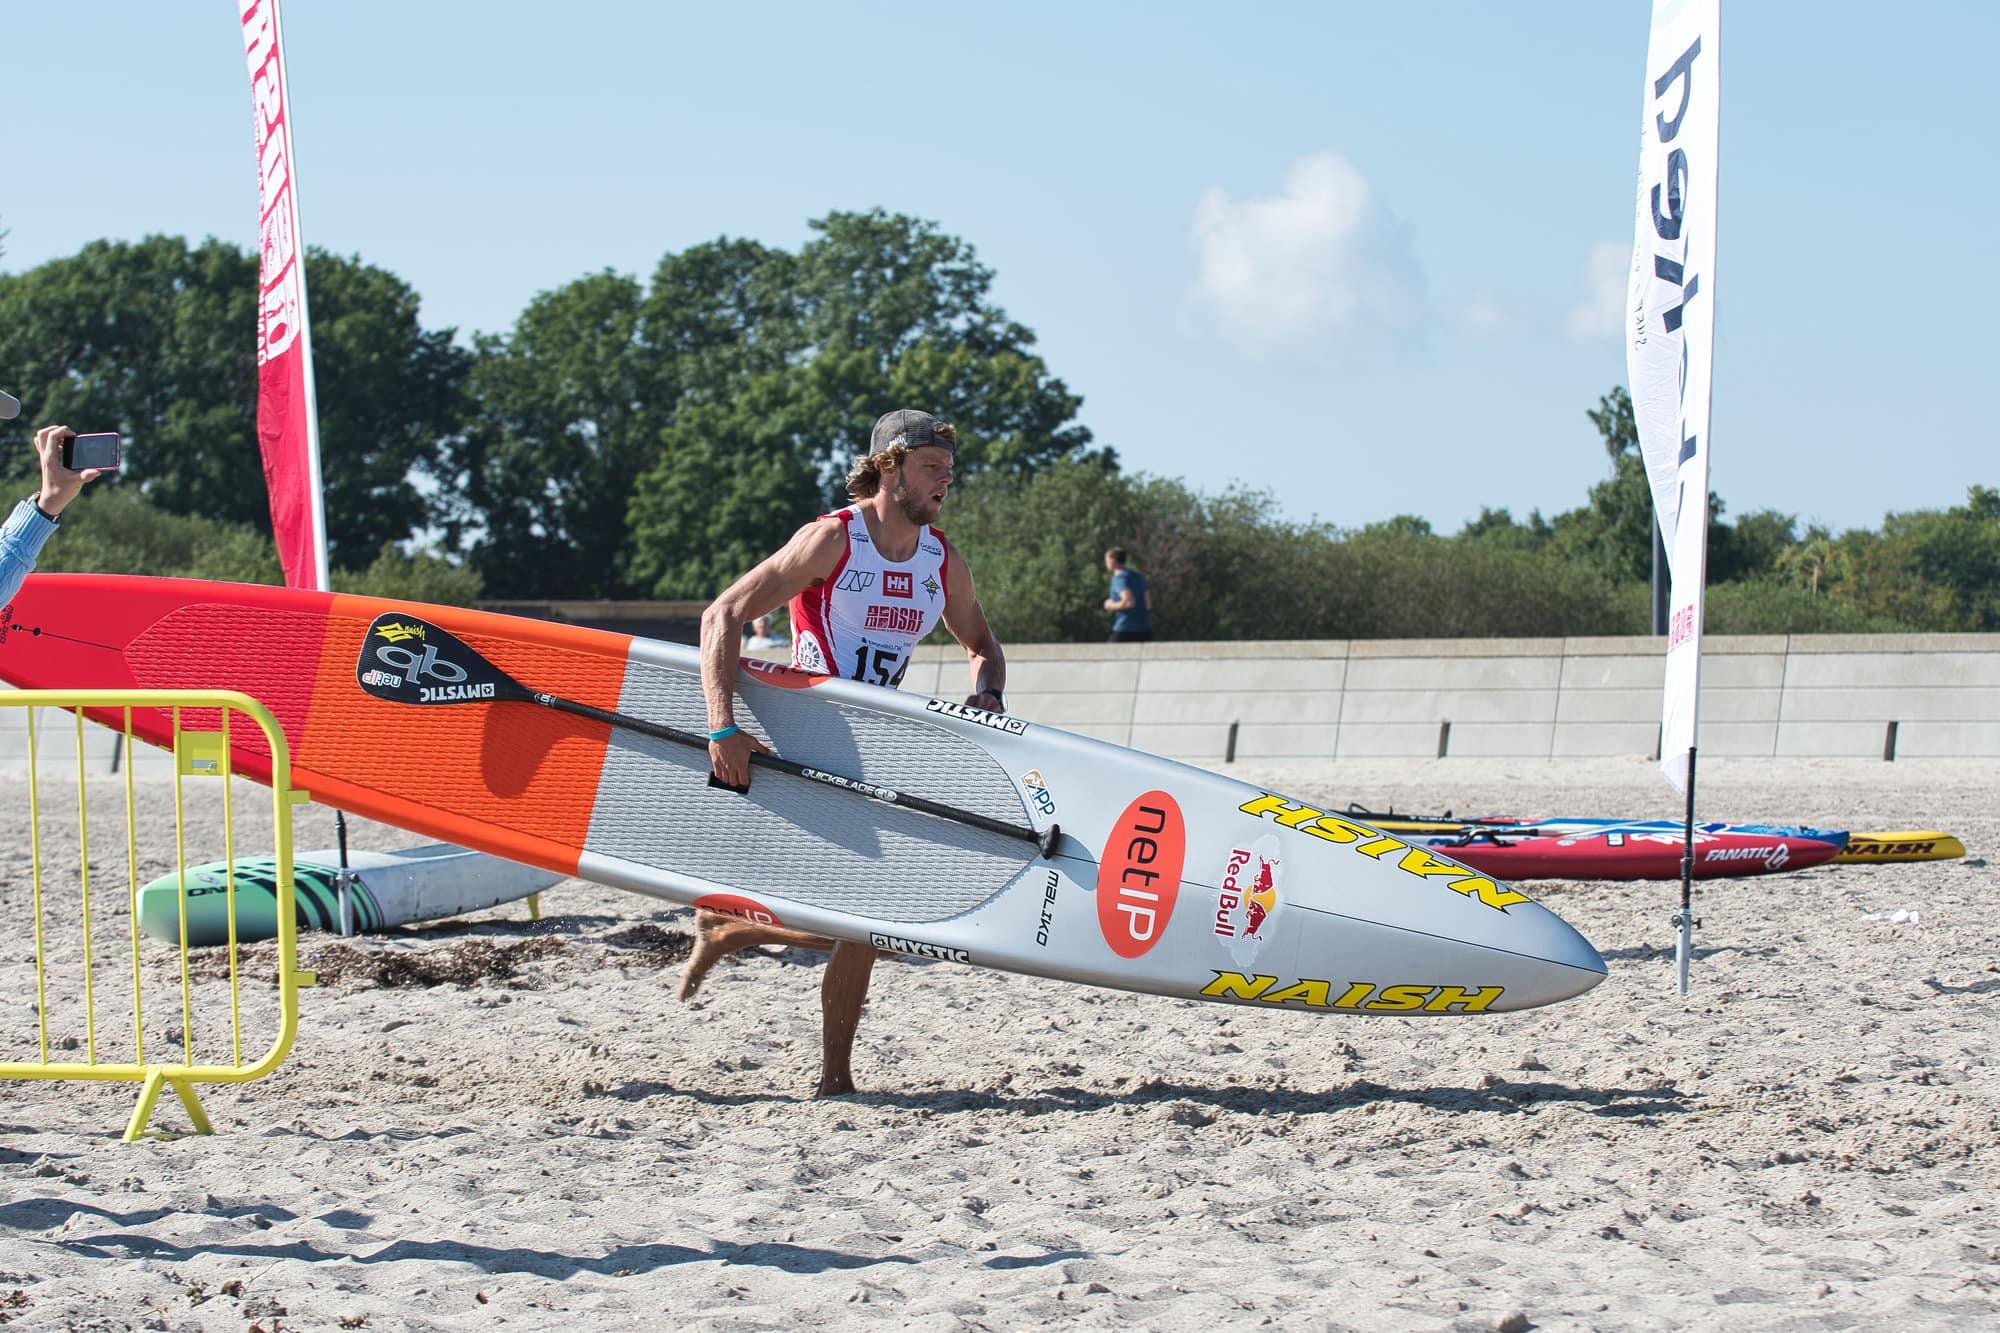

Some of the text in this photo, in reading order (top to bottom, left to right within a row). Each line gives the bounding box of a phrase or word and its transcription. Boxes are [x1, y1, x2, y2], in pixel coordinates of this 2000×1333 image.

[887, 576, 909, 589] HH
[419, 683, 480, 702] MYSTIC
[930, 699, 1006, 730] MYSTIC
[801, 768, 875, 794] QUICKBLADE
[1027, 785, 1056, 817] APP
[1239, 792, 1532, 914] NAISH
[1704, 847, 1773, 862] FANATIC
[1838, 842, 1936, 856] NAISH
[1115, 805, 1167, 943] netIP
[1214, 849, 1250, 938] Red Bull
[888, 936, 968, 964] MYSTIC
[1201, 969, 1505, 1014] NAISH
